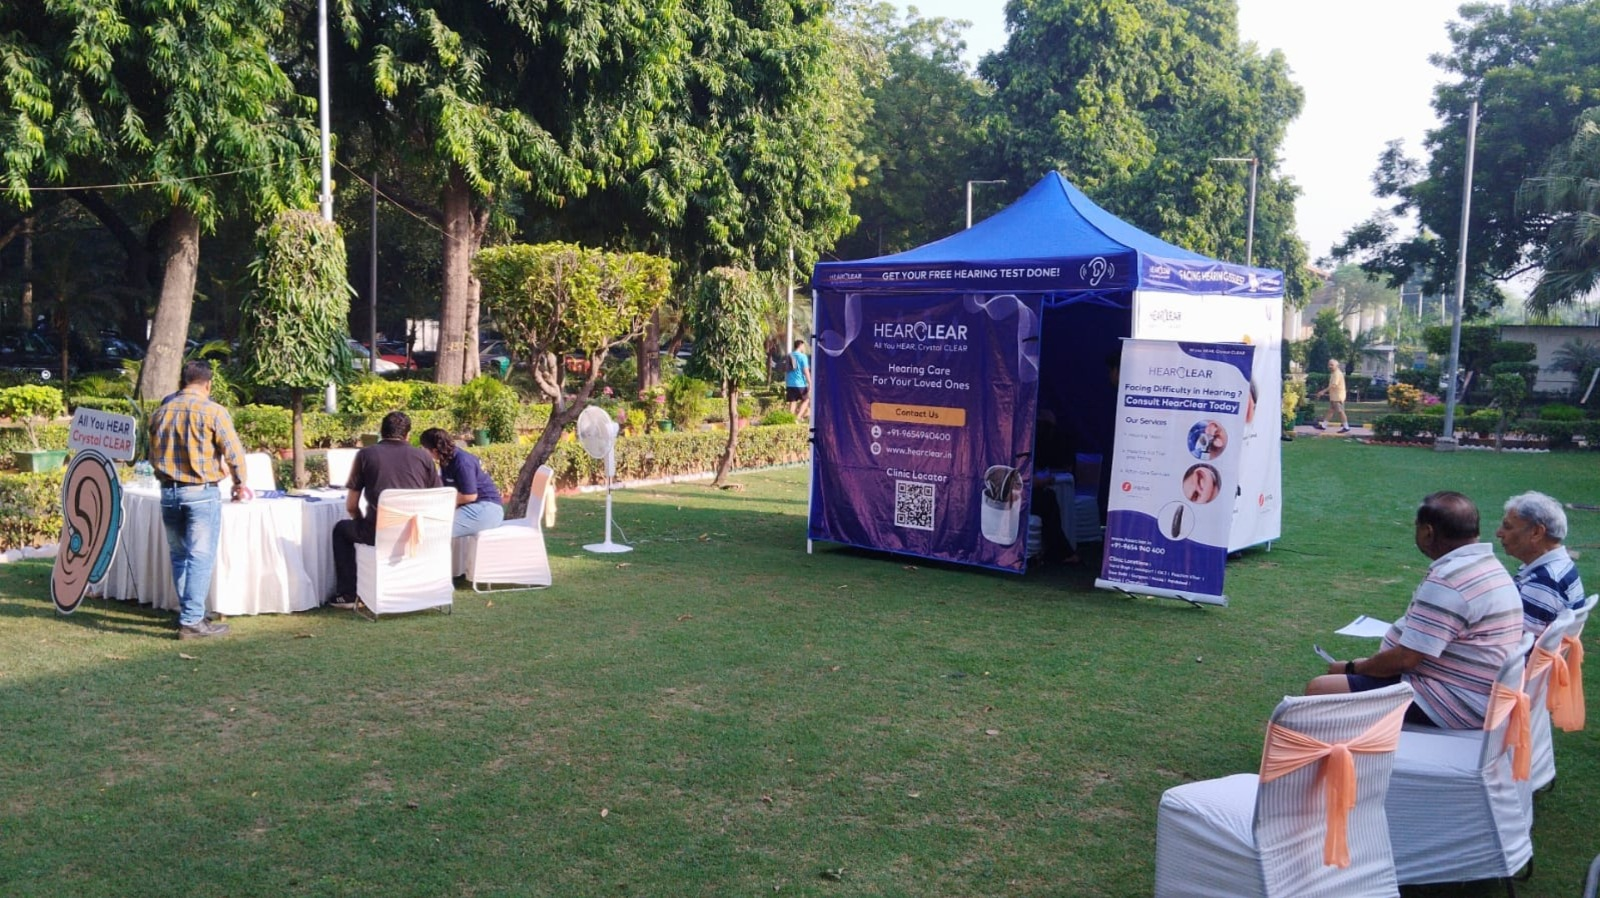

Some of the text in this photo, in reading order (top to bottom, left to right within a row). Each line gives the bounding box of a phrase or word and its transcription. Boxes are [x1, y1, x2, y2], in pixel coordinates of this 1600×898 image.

[882, 268, 1061, 281] GET YOUR FREE HEARING TEST DONE!
[1179, 269, 1202, 282] FACING
[874, 320, 968, 342] HEARCLEAR
[883, 342, 895, 350] You
[896, 342, 918, 351] HEAR,
[918, 344, 942, 352] Crystal
[944, 344, 968, 352] CLEAR
[888, 364, 951, 376] Hearing Care
[1148, 366, 1213, 379] HEARCLEAR
[872, 376, 970, 390] For Your Loved Ones
[1124, 384, 1152, 394] Facing
[1153, 384, 1192, 395] Difficulty
[1202, 388, 1236, 398] Hearing
[1126, 396, 1238, 412] Consult HearClear Today
[896, 408, 939, 419] Contact Us
[78, 414, 130, 435] All You HEAR
[1125, 416, 1167, 426] Our Services
[72, 430, 131, 452] Crystal CLEAR
[886, 428, 951, 441] +91-9654940400
[886, 446, 952, 459] www.hearclear.in
[886, 468, 948, 482] Clinic Locator
[1152, 546, 1166, 555] 400
